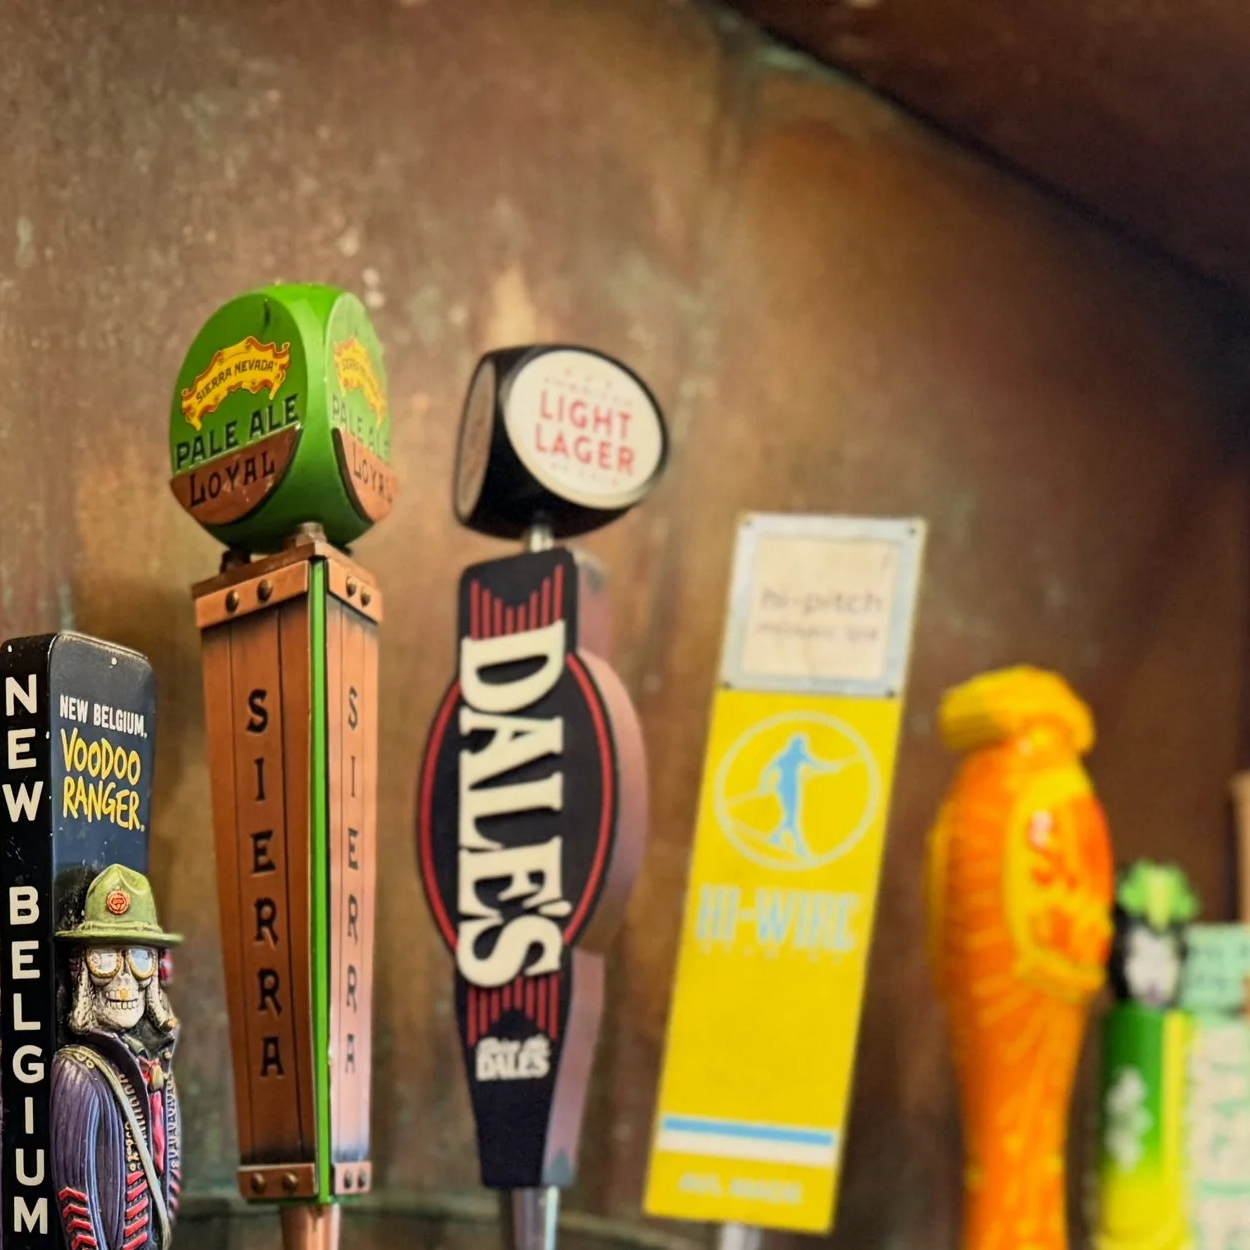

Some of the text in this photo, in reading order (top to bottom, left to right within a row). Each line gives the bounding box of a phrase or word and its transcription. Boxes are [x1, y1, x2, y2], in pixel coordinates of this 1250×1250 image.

[195, 359, 274, 403] SIERRA NEVADA
[176, 394, 299, 470] PALE ALE
[539, 390, 633, 440] LIGHT
[535, 423, 636, 476] LAGER
[190, 451, 275, 507] LOYAL
[60, 695, 88, 724] NEW
[61, 727, 141, 785] VOODOO
[459, 620, 572, 987] DALE'S
[246, 689, 283, 1078] SIERRA
[347, 686, 359, 1074] SIERRA
[2, 674, 49, 1236] NEW BELGIUM
